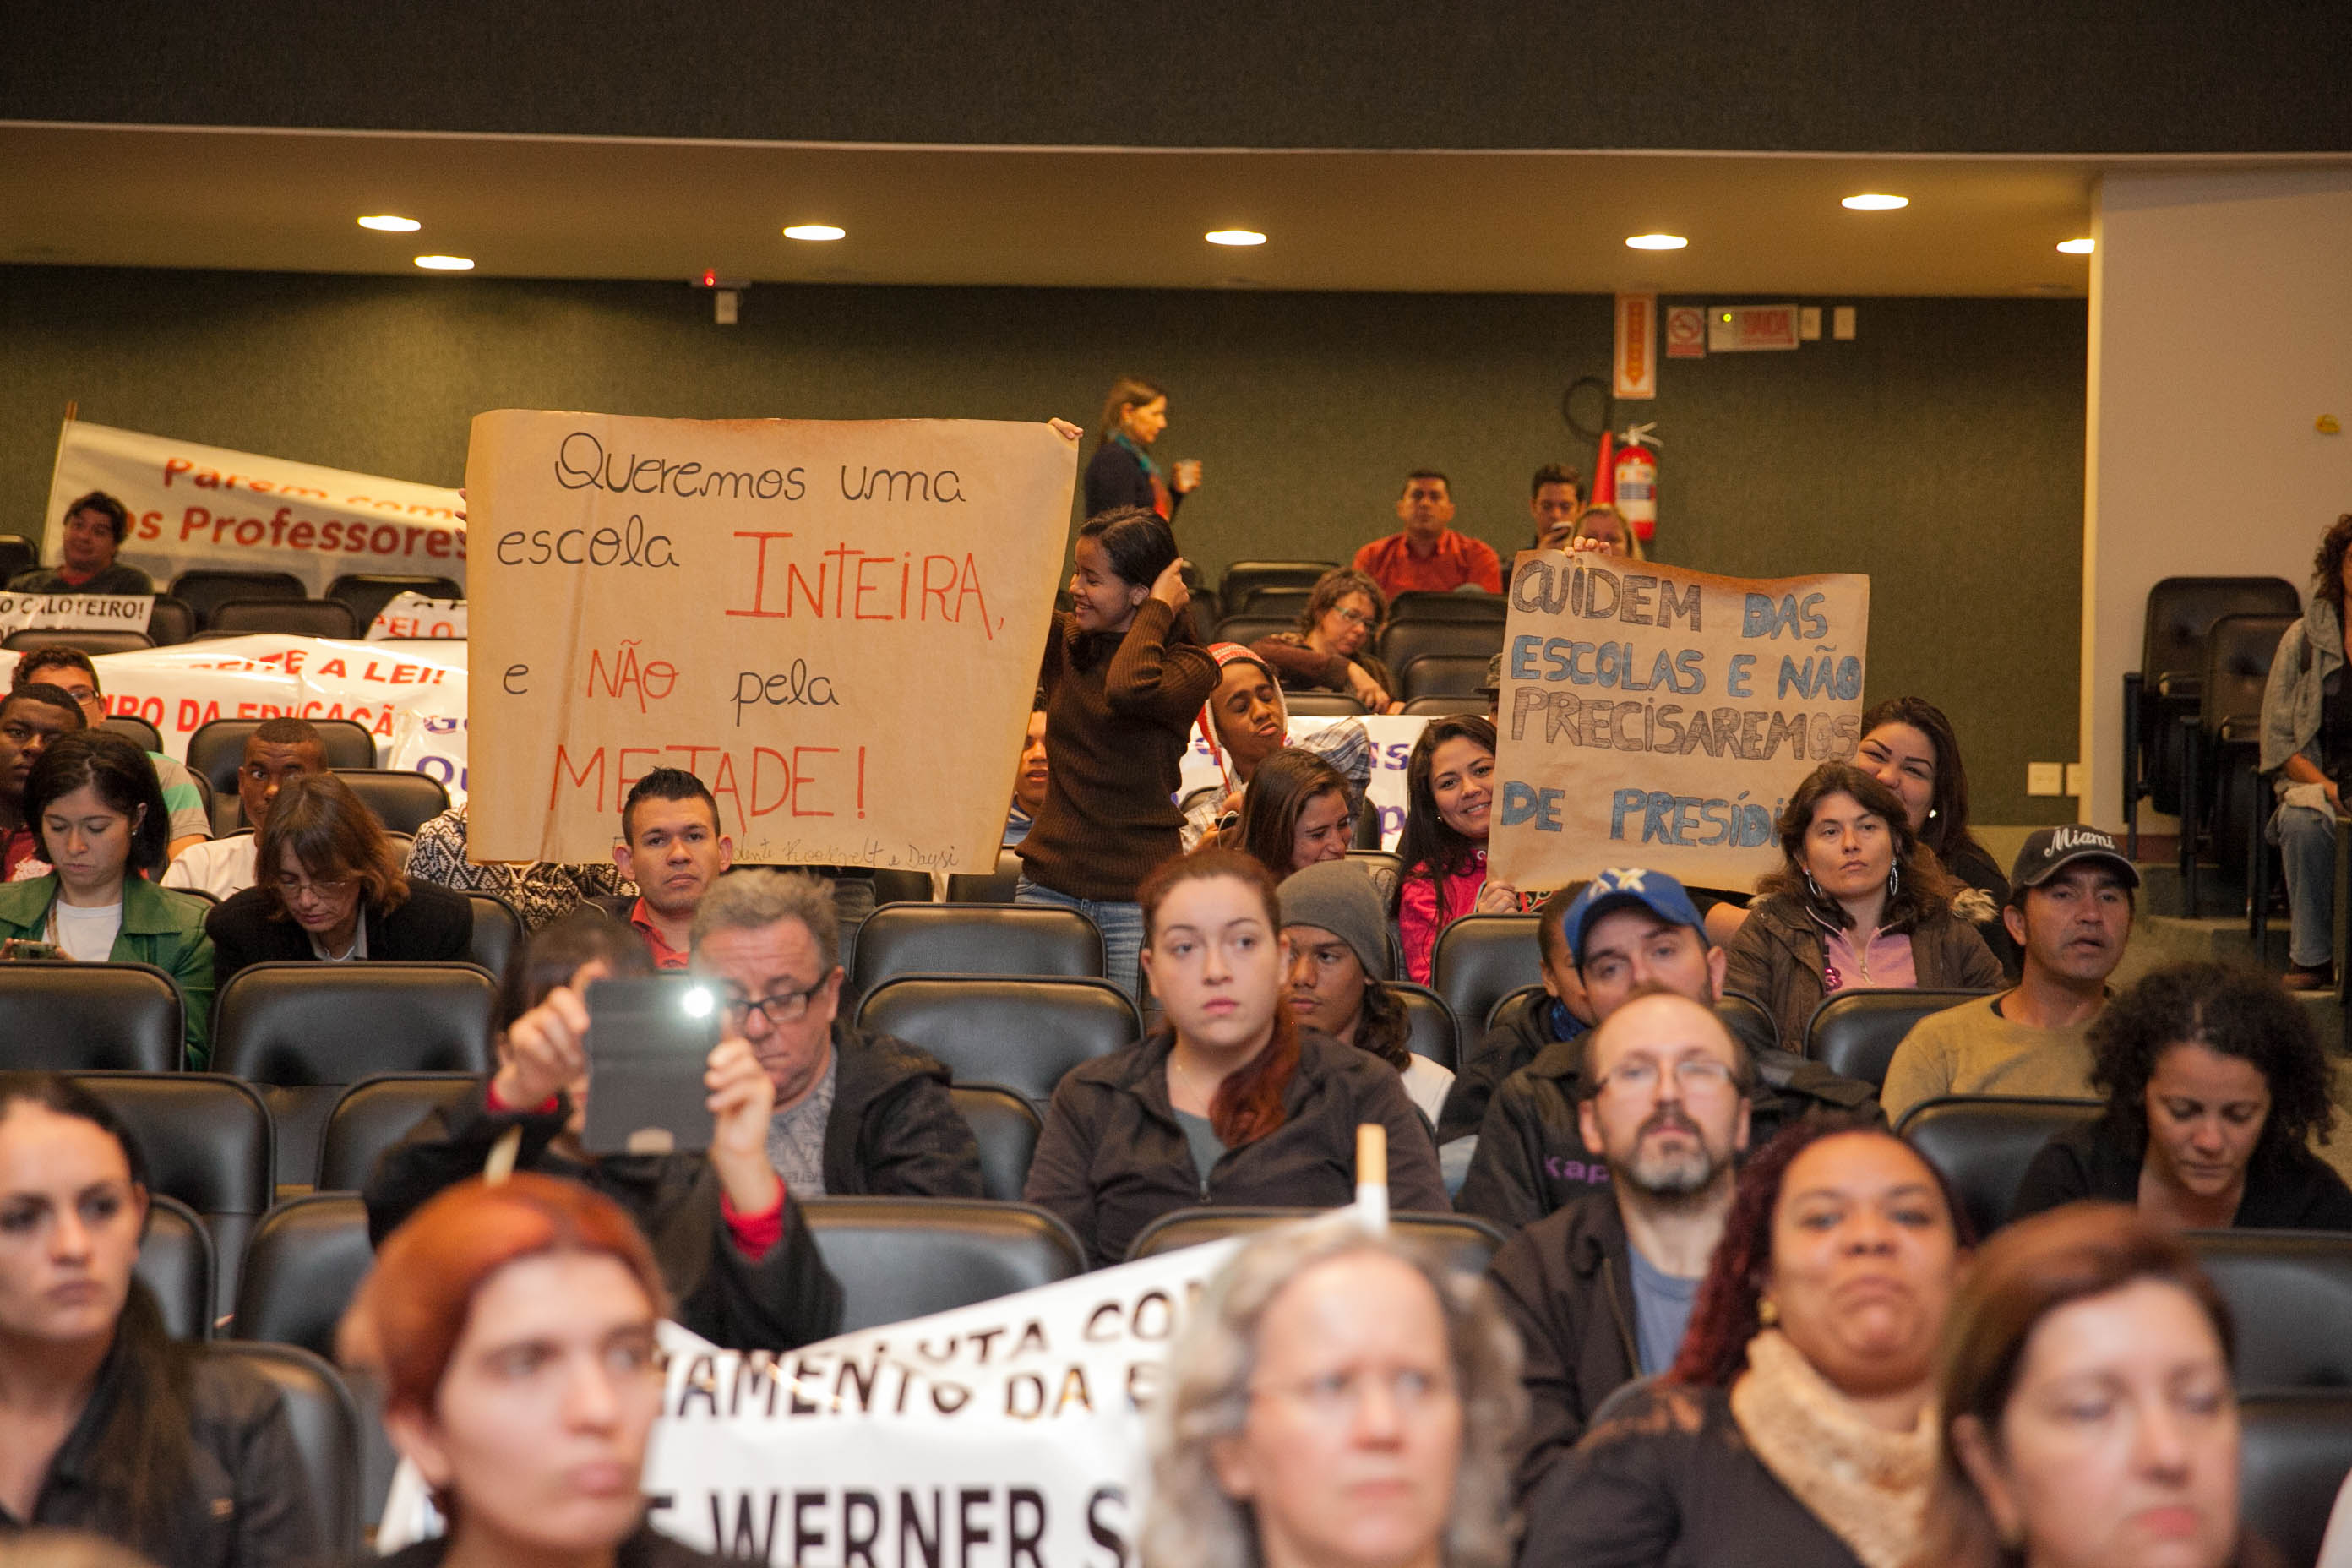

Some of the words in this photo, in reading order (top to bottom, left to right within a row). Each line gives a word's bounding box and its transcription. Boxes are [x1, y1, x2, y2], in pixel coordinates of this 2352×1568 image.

[163, 456, 329, 499] Parem
[554, 432, 806, 499] Queremos
[841, 466, 966, 502] uma
[496, 514, 680, 568] escola
[1742, 591, 1829, 640] DAS
[318, 659, 347, 678] A
[363, 662, 446, 685] LEI!
[503, 664, 530, 695] e
[587, 639, 679, 714] NÃO
[730, 657, 840, 727] pela
[1511, 635, 1706, 695] ESCOLAS
[1728, 654, 1756, 698] E
[1777, 644, 1863, 700] NÃO
[176, 698, 220, 732] DA
[1511, 687, 1861, 762] PRECISAREMOS
[1501, 781, 1565, 832] DE
[2044, 826, 2115, 858] Miami
